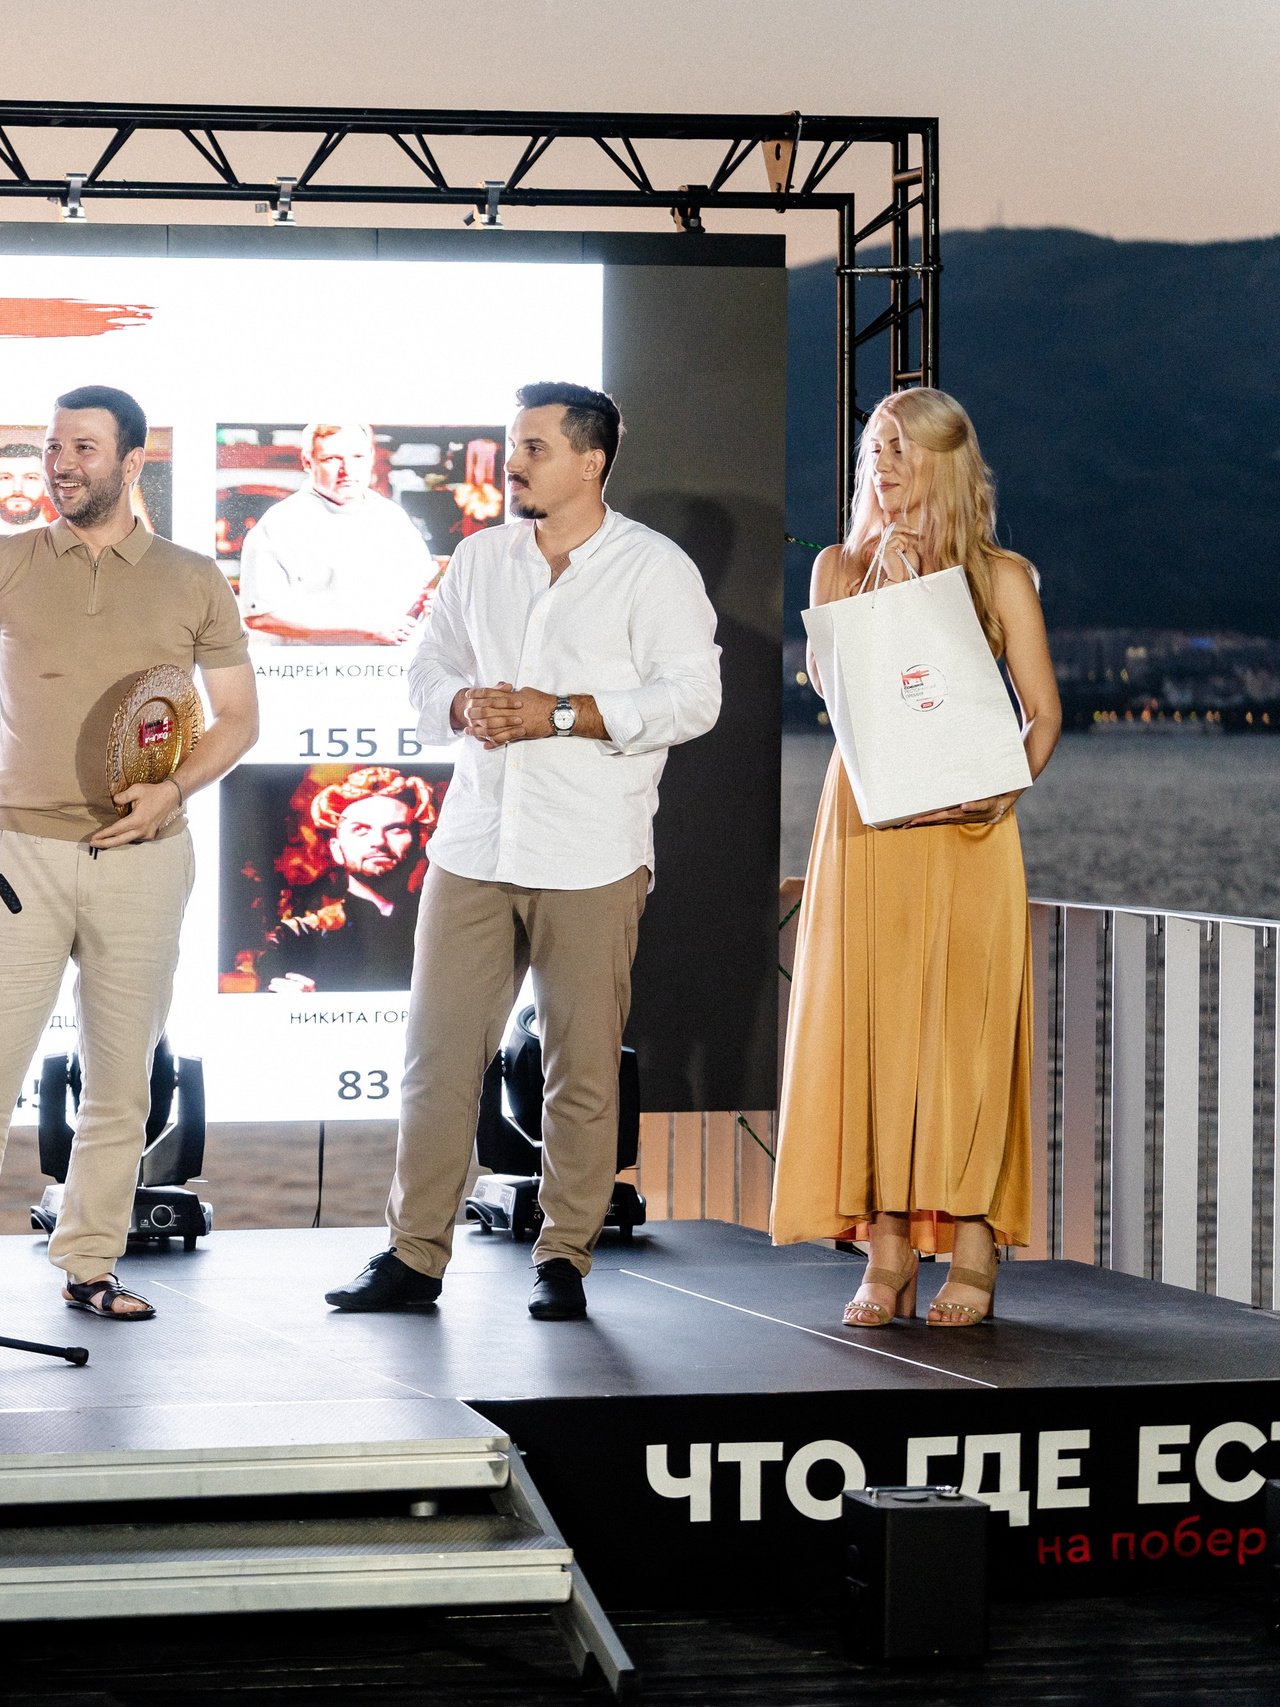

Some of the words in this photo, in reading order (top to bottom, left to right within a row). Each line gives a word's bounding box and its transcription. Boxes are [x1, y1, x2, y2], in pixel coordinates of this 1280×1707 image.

[256, 662, 328, 678] АНДРЕЙ
[335, 664, 409, 678] КОЛЕСН
[299, 728, 377, 758] 155
[397, 728, 423, 757] Б
[290, 1011, 368, 1025] НИКИТА
[375, 1010, 409, 1023] ГОР
[337, 1070, 390, 1100] 83
[646, 1439, 866, 1522] ЧТО
[907, 1429, 1090, 1527] ГДЕ
[1137, 1421, 1280, 1505] ЕС
[1038, 1534, 1091, 1564] на
[1112, 1515, 1267, 1565] побер
